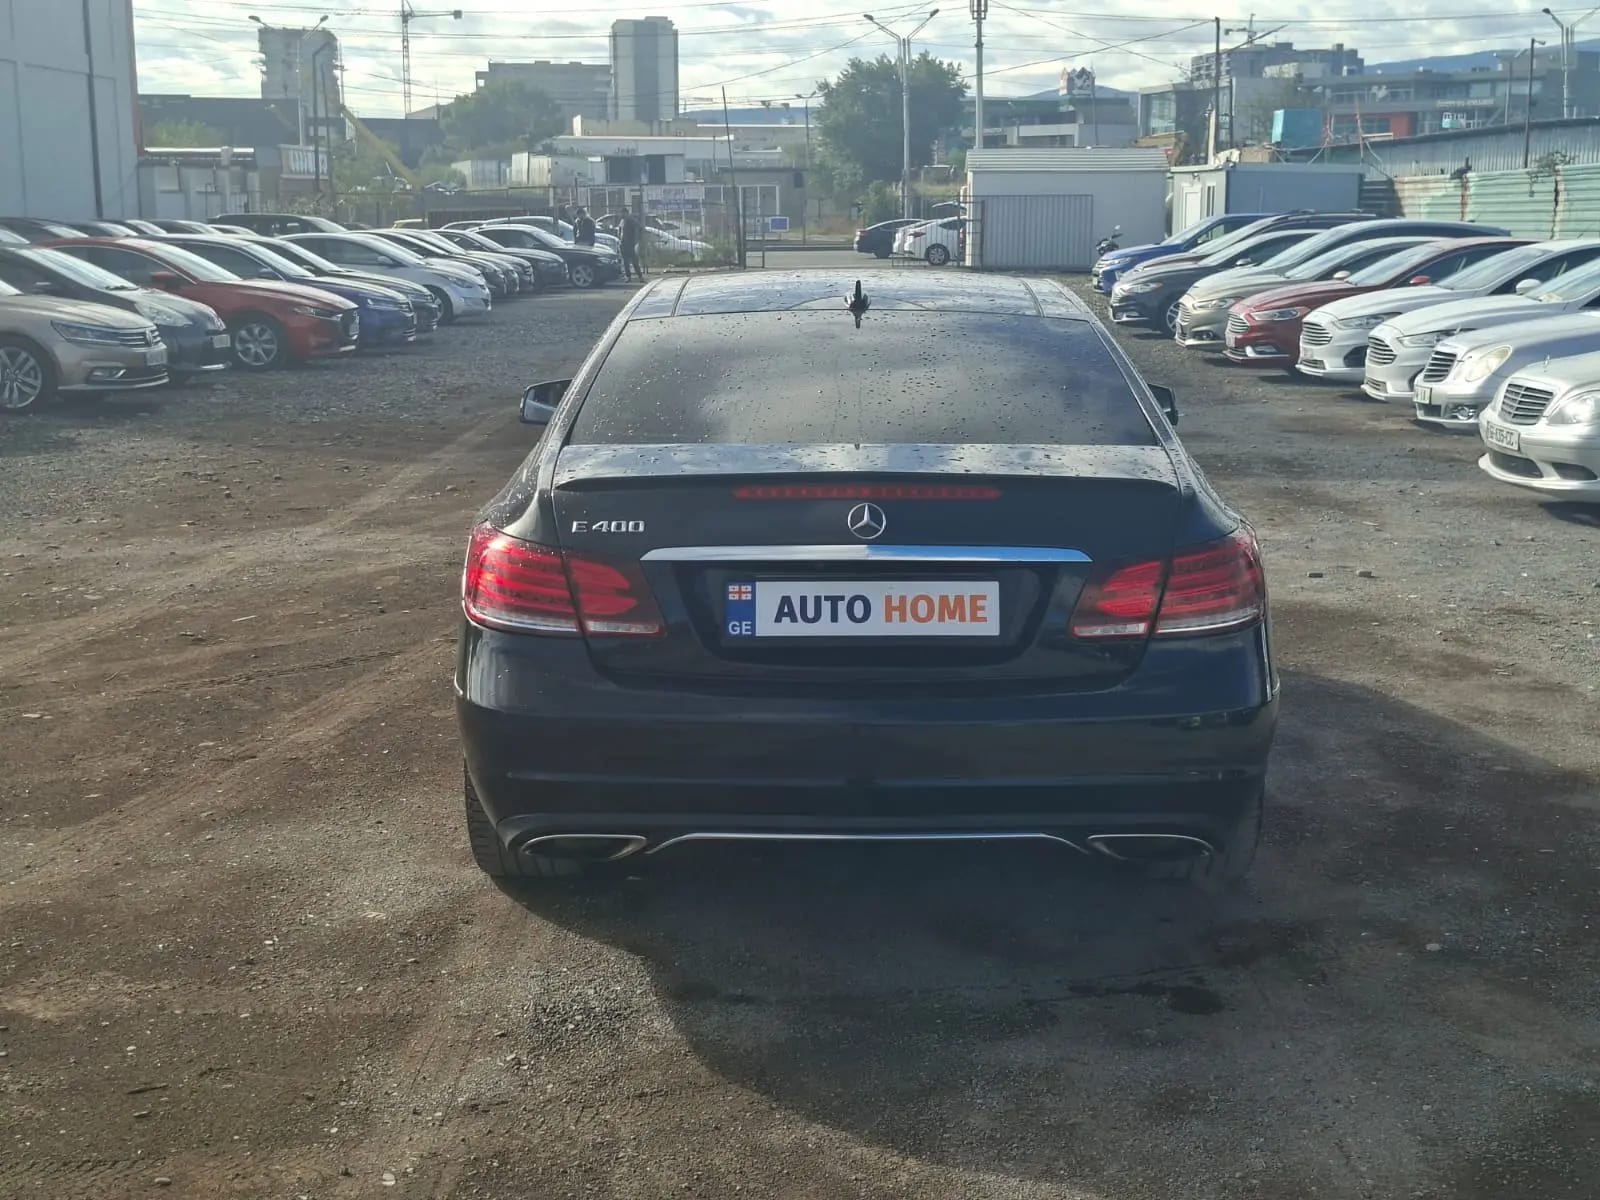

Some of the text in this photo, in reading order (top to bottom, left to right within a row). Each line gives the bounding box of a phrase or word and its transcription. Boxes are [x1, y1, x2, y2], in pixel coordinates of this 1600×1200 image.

[571, 520, 645, 533] E 400
[773, 594, 988, 624] AUTO HOME
[728, 621, 753, 636] GE
